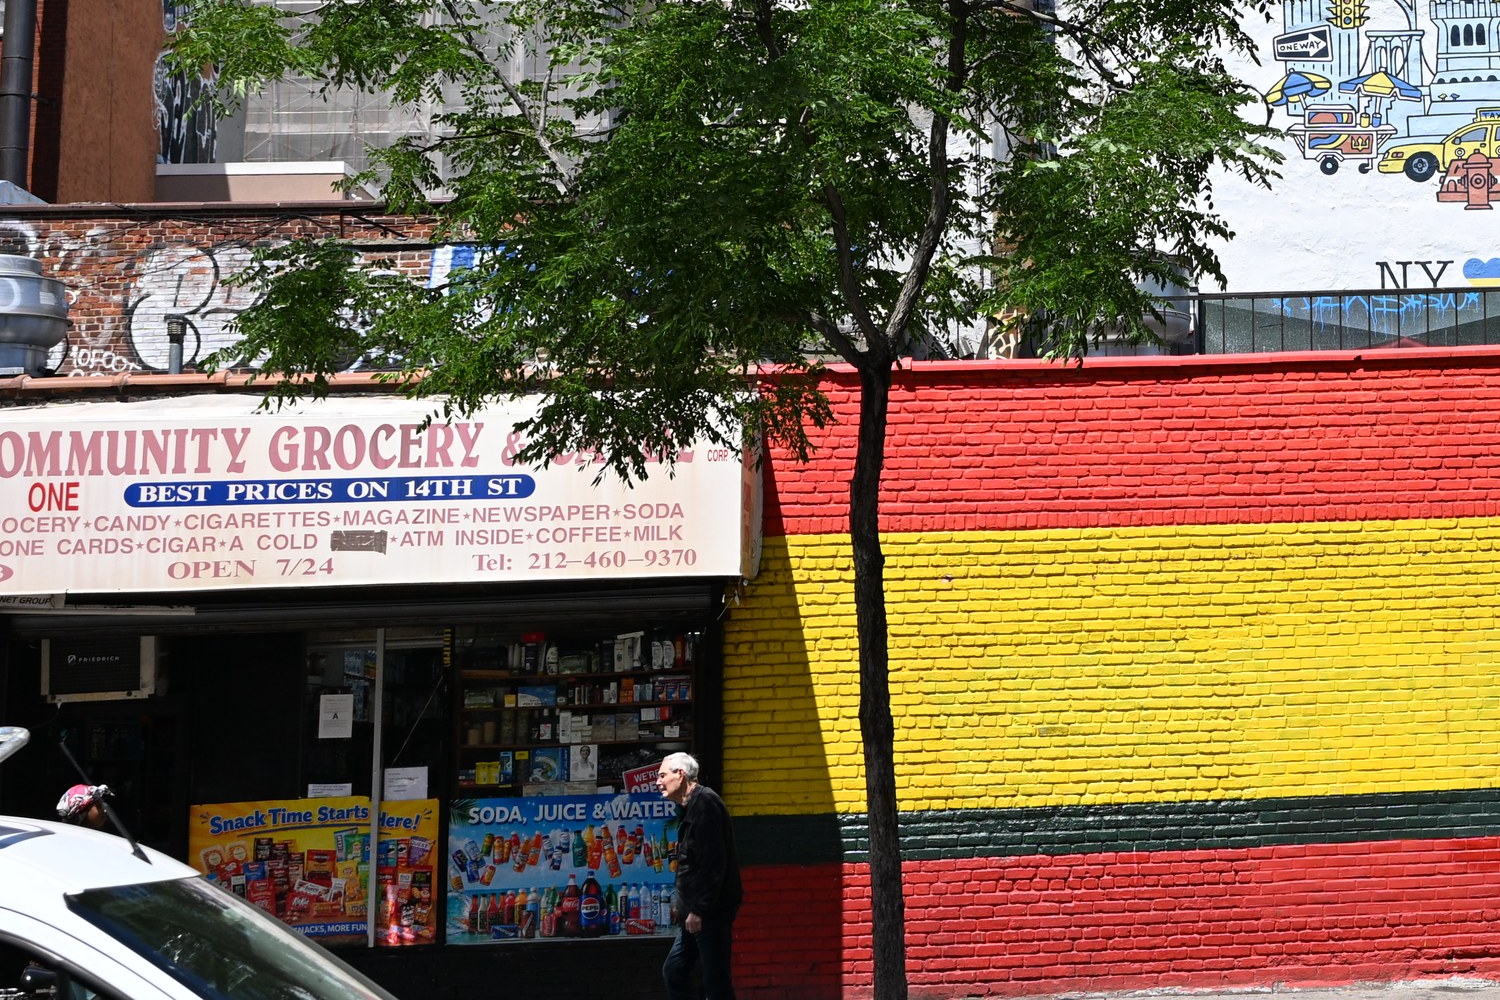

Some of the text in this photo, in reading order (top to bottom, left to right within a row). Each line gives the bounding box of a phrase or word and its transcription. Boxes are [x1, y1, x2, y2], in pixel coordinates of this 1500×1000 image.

[0, 428, 251, 478] OMMUNITY
[268, 422, 484, 472] GROCERY
[28, 482, 80, 512] ONE
[138, 478, 522, 503] BEST PRICES ON 14TH ST
[1, 502, 685, 534] OCERY CANDY CIGARETTES MAGAZINE NEWSPAPER SODA
[0, 524, 684, 557] ONE CARDS CIGAR A COLD ATM INSIDE COFFEE MILK
[167, 557, 334, 580] OPEN 7/24
[472, 548, 697, 572] Tel: 212-460-9370
[19, 596, 51, 605] GROUP
[78, 655, 120, 663] FRIEDRICH
[331, 712, 339, 720] A
[631, 780, 661, 793] OPE
[210, 809, 266, 835] Snack
[268, 807, 313, 825] Time
[317, 805, 369, 822] Starts
[468, 800, 677, 825] SODA, JUICE & WATER
[327, 924, 350, 932] MORE
[351, 923, 367, 931] FUN
